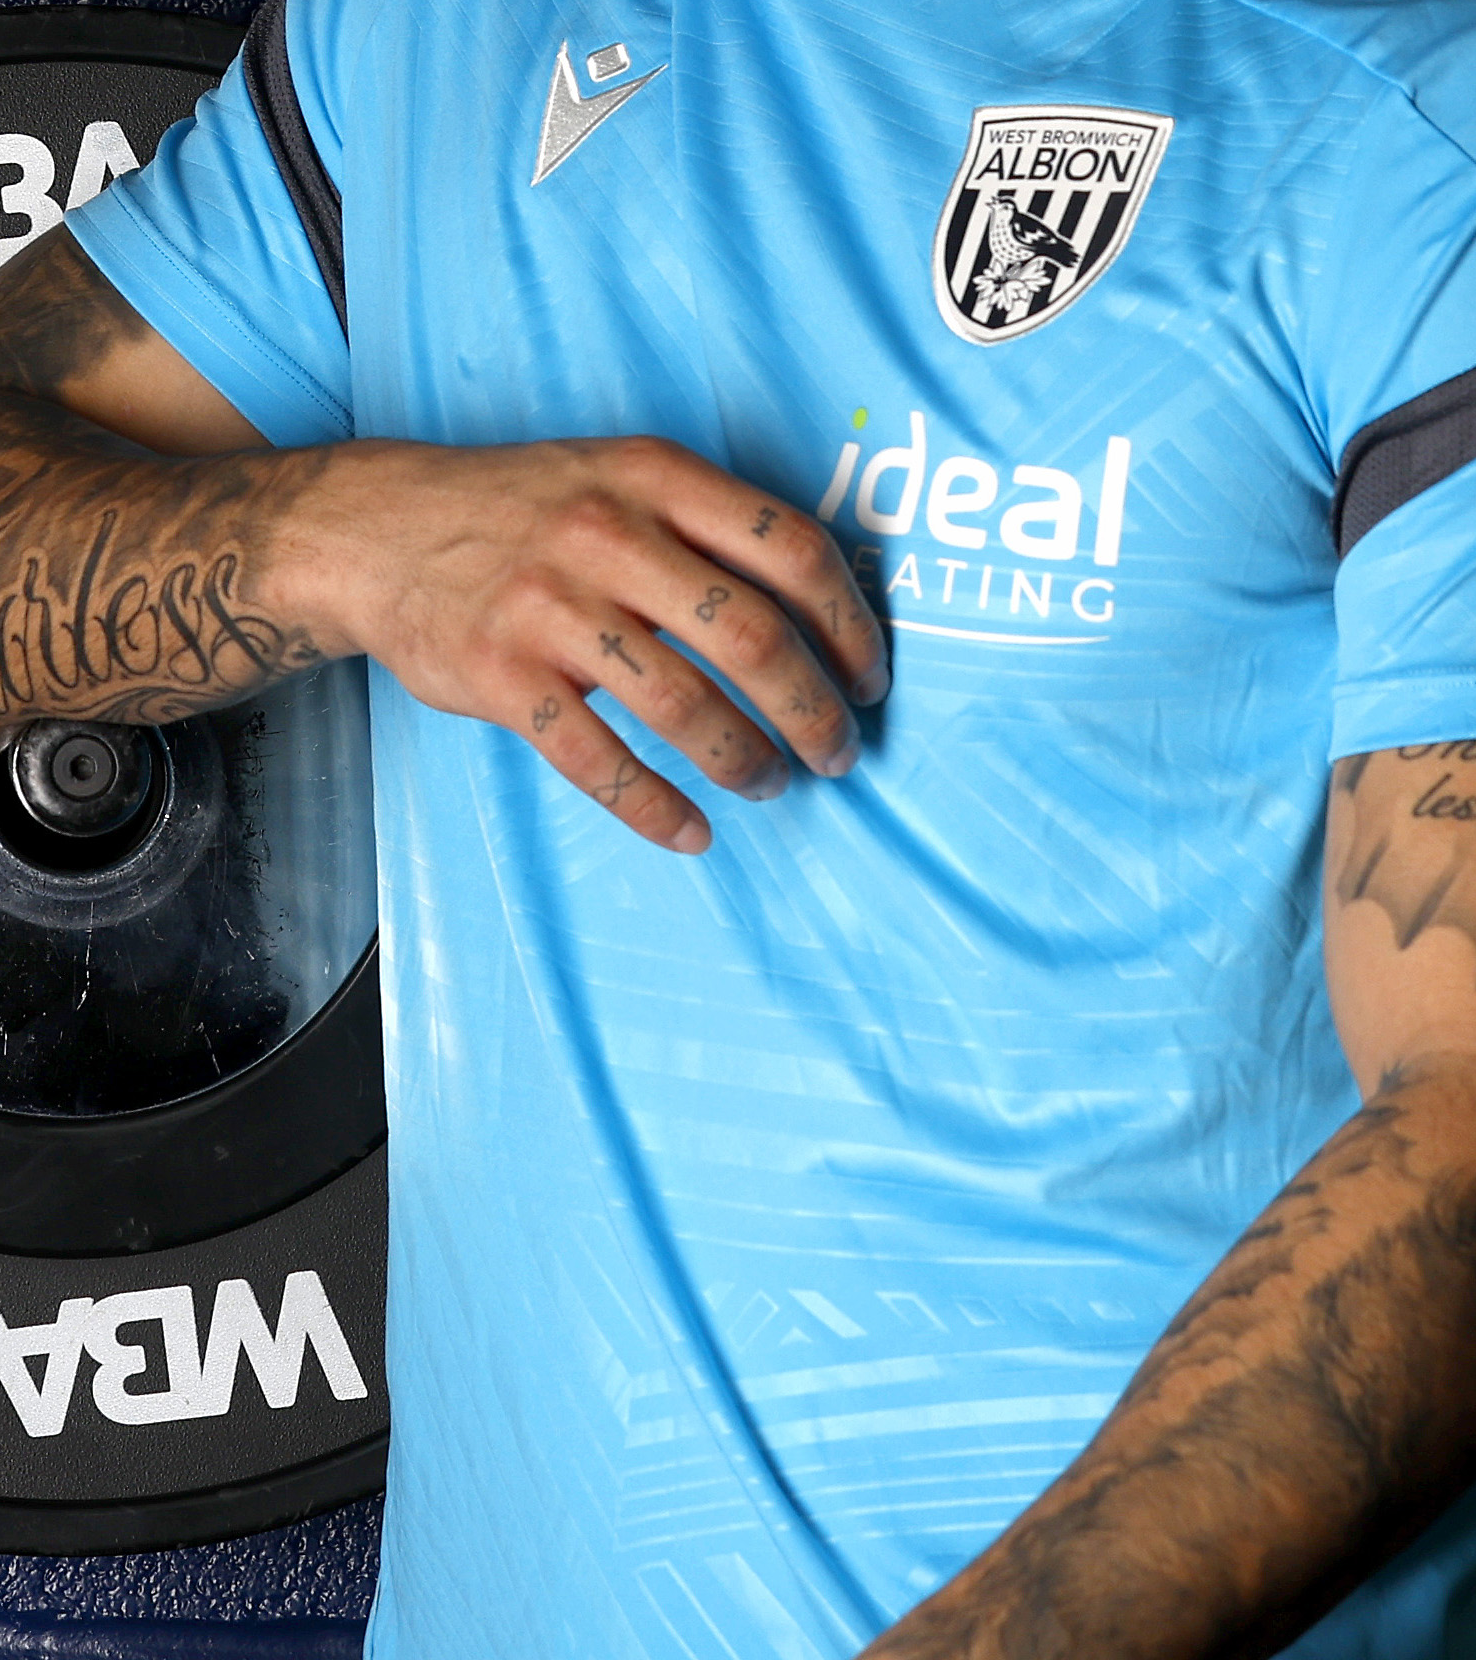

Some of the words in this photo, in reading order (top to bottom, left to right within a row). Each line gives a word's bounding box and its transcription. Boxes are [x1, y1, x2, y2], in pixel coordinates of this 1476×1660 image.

[975, 147, 1136, 183] ALBION
[989, 129, 1037, 145] WEST
[1041, 129, 1143, 148] BROMWICH
[817, 406, 1132, 568] ideal
[852, 544, 1116, 624] EATING
